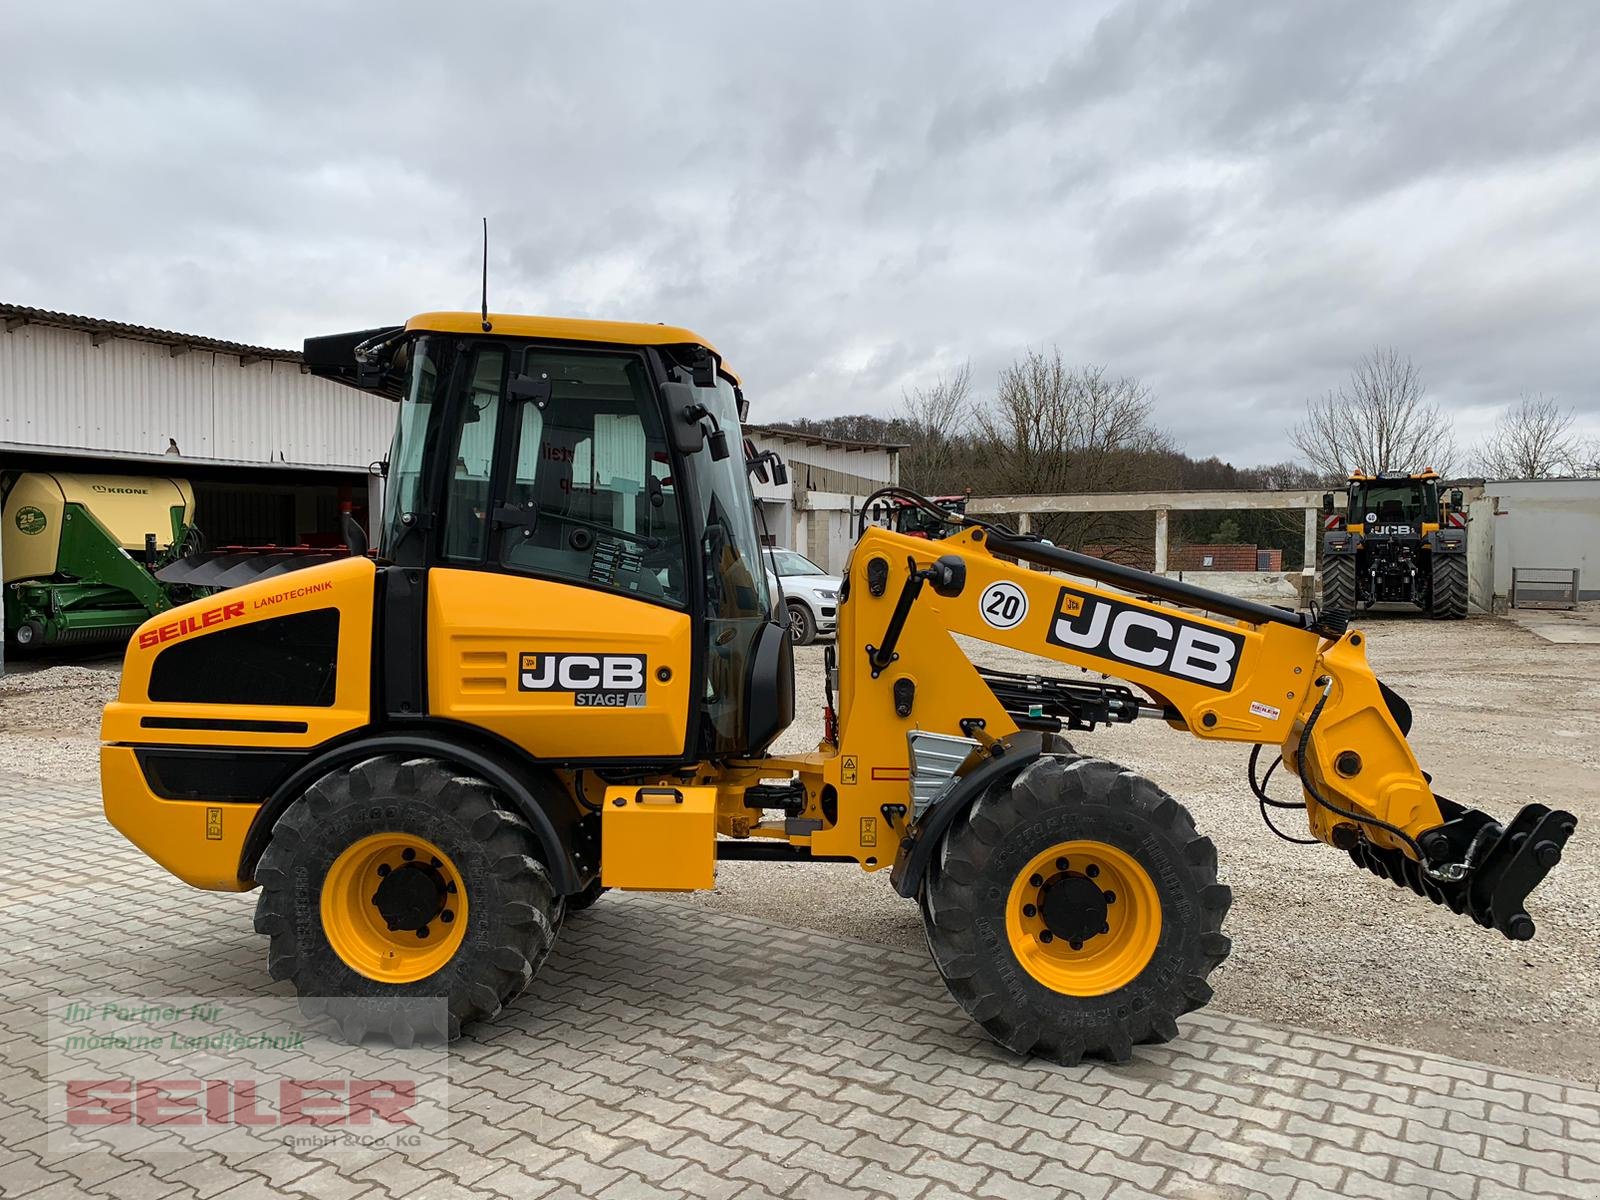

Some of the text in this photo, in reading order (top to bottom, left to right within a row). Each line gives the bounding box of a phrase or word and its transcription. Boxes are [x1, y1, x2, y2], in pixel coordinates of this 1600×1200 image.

[107, 487, 149, 495] KRONE
[1374, 525, 1411, 535] JCB
[253, 581, 333, 609] LANDTECHNIK
[986, 591, 1020, 620] 20
[138, 600, 246, 650] SEILER
[1055, 602, 1236, 685] JCB
[522, 656, 643, 689] JCB
[576, 693, 625, 706] STAGE
